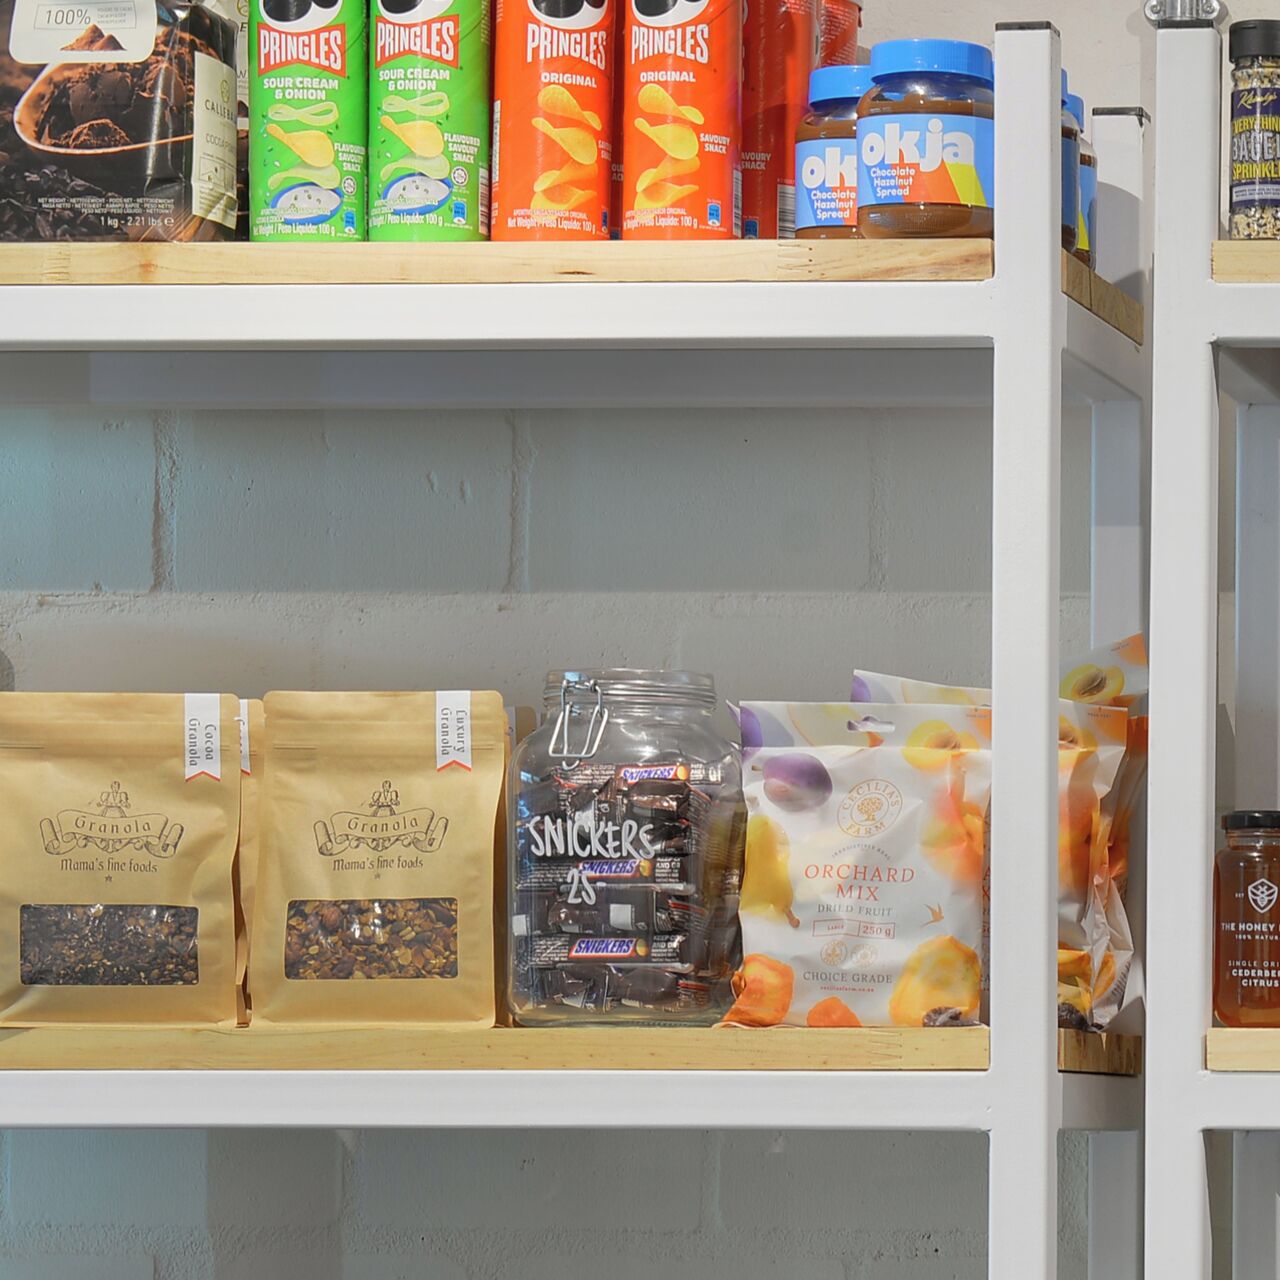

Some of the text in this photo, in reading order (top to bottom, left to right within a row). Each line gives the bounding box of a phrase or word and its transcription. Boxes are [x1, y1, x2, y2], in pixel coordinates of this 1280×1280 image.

[46, 10, 91, 25] 100%
[376, 20, 455, 62] PRINGLES
[526, 22, 607, 71] PRINGLES
[631, 23, 709, 65] PRINGLES
[260, 29, 342, 71] PRINGLES
[379, 69, 450, 81] SOUR CREAM
[540, 71, 597, 89] ORIGINAL
[640, 71, 696, 83] ORIGINAL
[263, 78, 338, 90] SOUR CREAM
[388, 80, 437, 91] & ONION
[275, 89, 326, 100] & ONION
[700, 133, 731, 145] SAVOURY
[861, 118, 975, 172] okja
[704, 143, 727, 154] SNACK
[870, 166, 916, 178] Chocolate
[874, 176, 913, 187] Hazelnut
[811, 190, 856, 201] Chocolate
[876, 185, 910, 198] Spread
[814, 199, 854, 210] Hazelnut
[816, 209, 850, 220] Spread
[441, 707, 452, 756] Granola
[456, 709, 468, 755] Luxury
[188, 717, 200, 767] Granola
[204, 723, 217, 761] Cocoa
[75, 816, 151, 835] Granola
[347, 817, 420, 834] Granola
[847, 822, 886, 837] FARM
[527, 815, 655, 860] SNICKERS
[61, 856, 158, 873] Mama's fine foods
[333, 855, 424, 872] Mama's fine foods
[580, 860, 638, 877] SNICKERS
[804, 864, 915, 883] ORCHARD
[836, 884, 880, 902] MIX
[817, 904, 892, 917] DRIED FRUIT
[862, 925, 882, 936] 250
[1221, 922, 1236, 931] THE
[1238, 923, 1275, 933] HONEY
[574, 939, 635, 956] SNICKERS
[803, 972, 893, 984] CHOICE GRADE
[1241, 979, 1280, 988] CITRUS
